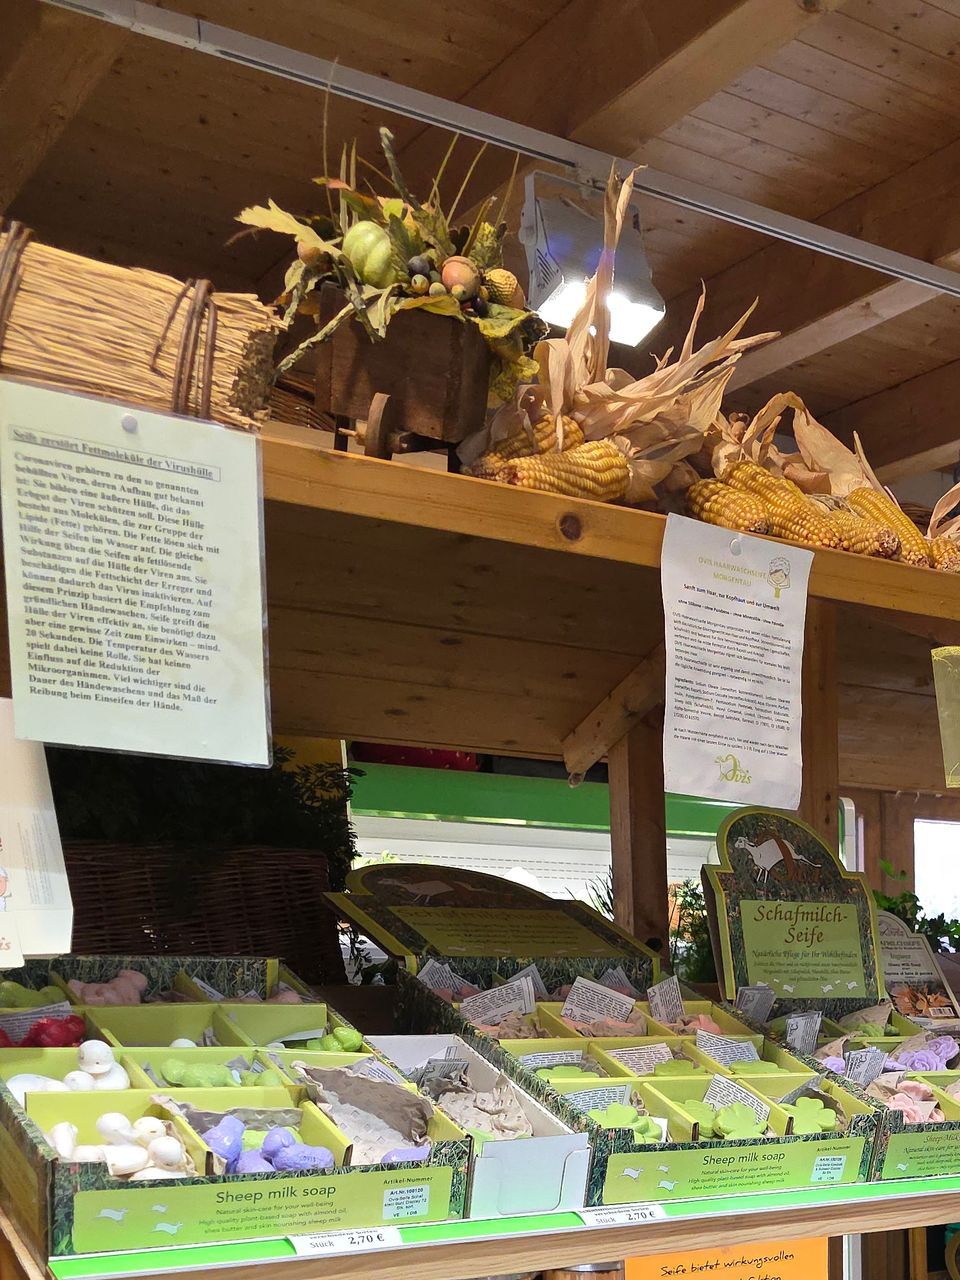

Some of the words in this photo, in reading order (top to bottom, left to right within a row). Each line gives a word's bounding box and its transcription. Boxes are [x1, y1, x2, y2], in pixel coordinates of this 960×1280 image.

[41, 435, 78, 451] zerstört
[82, 443, 144, 464] Fettmoleküle
[146, 456, 163, 468] der
[164, 461, 214, 478] Virushülle
[30, 687, 68, 700] Reibung
[70, 690, 92, 701] beim
[94, 694, 133, 707] Einseifen
[136, 698, 150, 707] der
[153, 701, 183, 712] Hände.
[753, 903, 847, 926] Schafmilch-
[784, 926, 824, 947] Seife
[702, 1154, 736, 1166] Sheep
[738, 1152, 759, 1163] milk
[762, 1151, 786, 1163] soap
[383, 1176, 433, 1185] Artikel-Nummer
[216, 1190, 263, 1204] Sheep
[268, 1185, 297, 1198] milk
[302, 1184, 336, 1198] soap
[216, 1207, 243, 1215] Natural
[243, 1205, 270, 1213] skin-care
[283, 1203, 298, 1212] your
[300, 1200, 334, 1210] well-being
[199, 1218, 215, 1226] High
[216, 1216, 239, 1226] quality
[240, 1212, 279, 1223] plant-based
[281, 1212, 297, 1220] soap
[298, 1210, 313, 1218] with
[314, 1208, 336, 1216] almond
[204, 1226, 220, 1234] shea
[222, 1224, 242, 1233] butter
[244, 1222, 257, 1231] and
[258, 1220, 271, 1229] skin
[273, 1218, 307, 1229] nourishing
[308, 1216, 326, 1226] sheep
[327, 1216, 342, 1224] milk
[595, 1217, 616, 1225] Stück
[627, 1211, 647, 1222] 2,70
[649, 1210, 656, 1218] €
[309, 1239, 335, 1249] Stück
[348, 1234, 374, 1246] 2,70
[377, 1233, 385, 1242] €
[660, 1265, 687, 1277] Seife
[691, 1261, 720, 1273] bietet
[724, 1251, 795, 1270] wirkungsvollen
